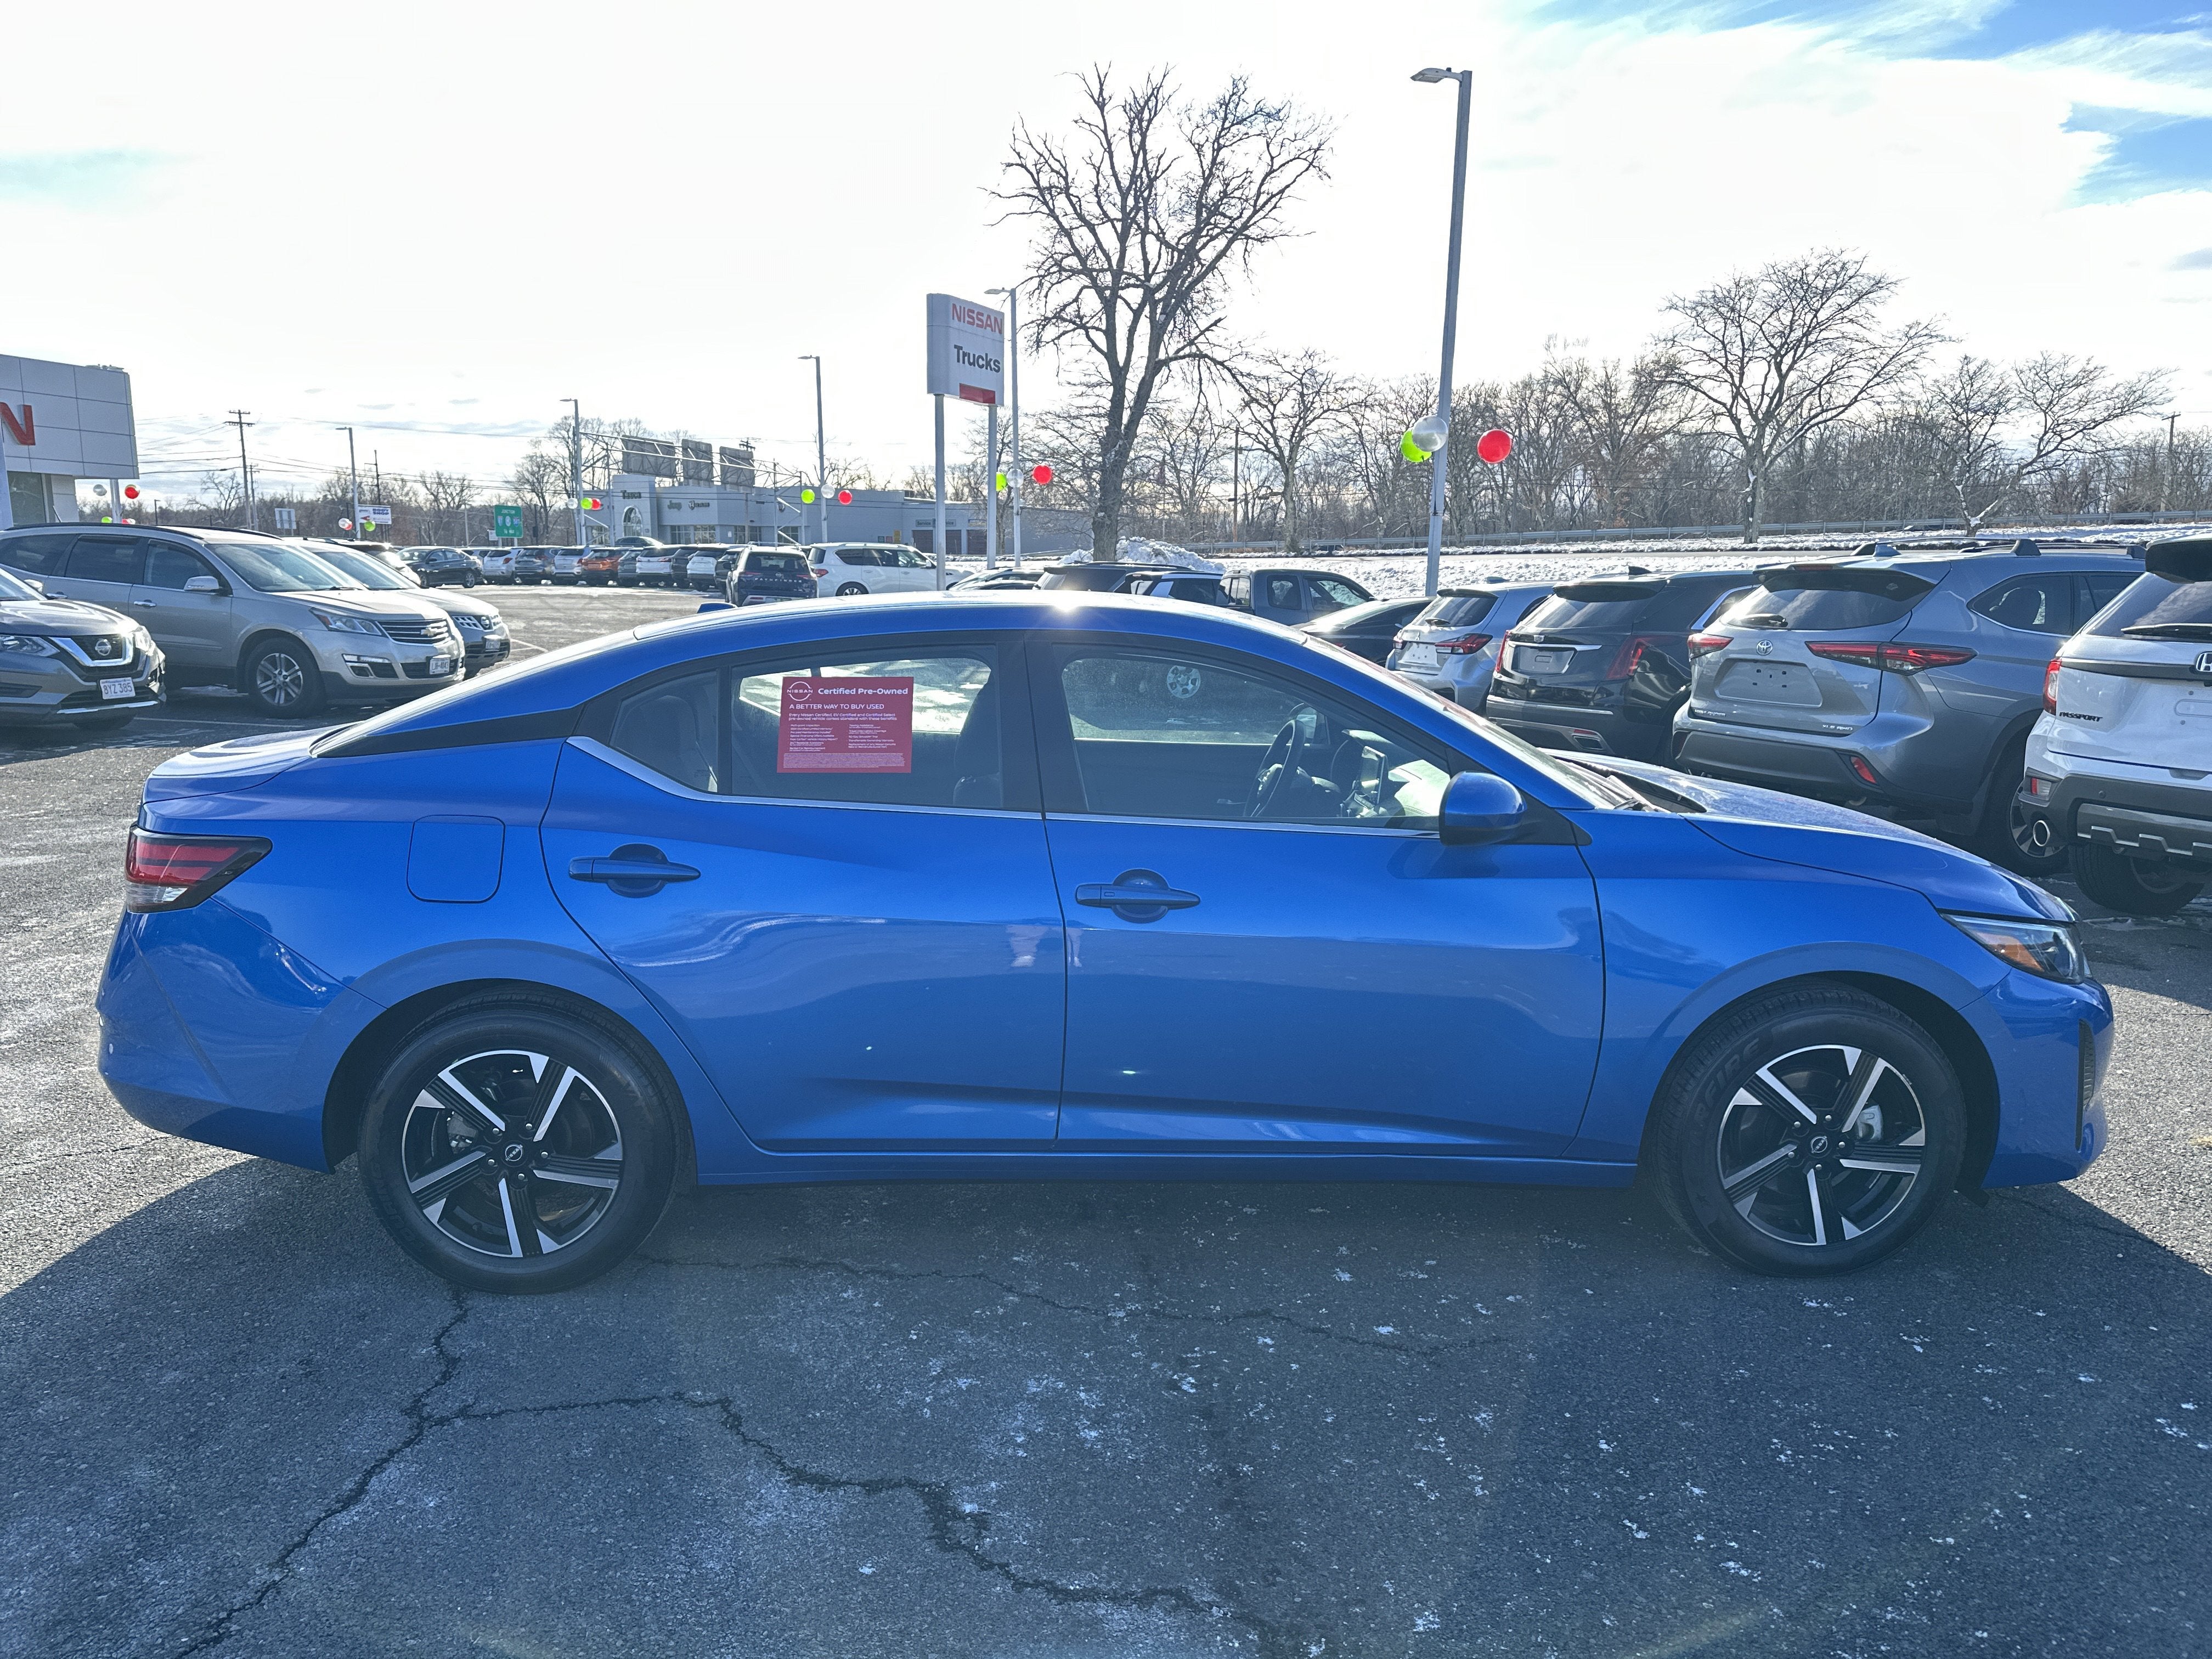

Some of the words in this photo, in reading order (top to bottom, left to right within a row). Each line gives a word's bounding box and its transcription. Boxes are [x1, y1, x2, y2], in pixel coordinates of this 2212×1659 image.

[952, 303, 1002, 334] NISSAN
[953, 344, 1001, 373] Trucks
[103, 684, 117, 695] 8YZ
[118, 682, 133, 693] 385
[2059, 712, 2103, 722] PASSPORT
